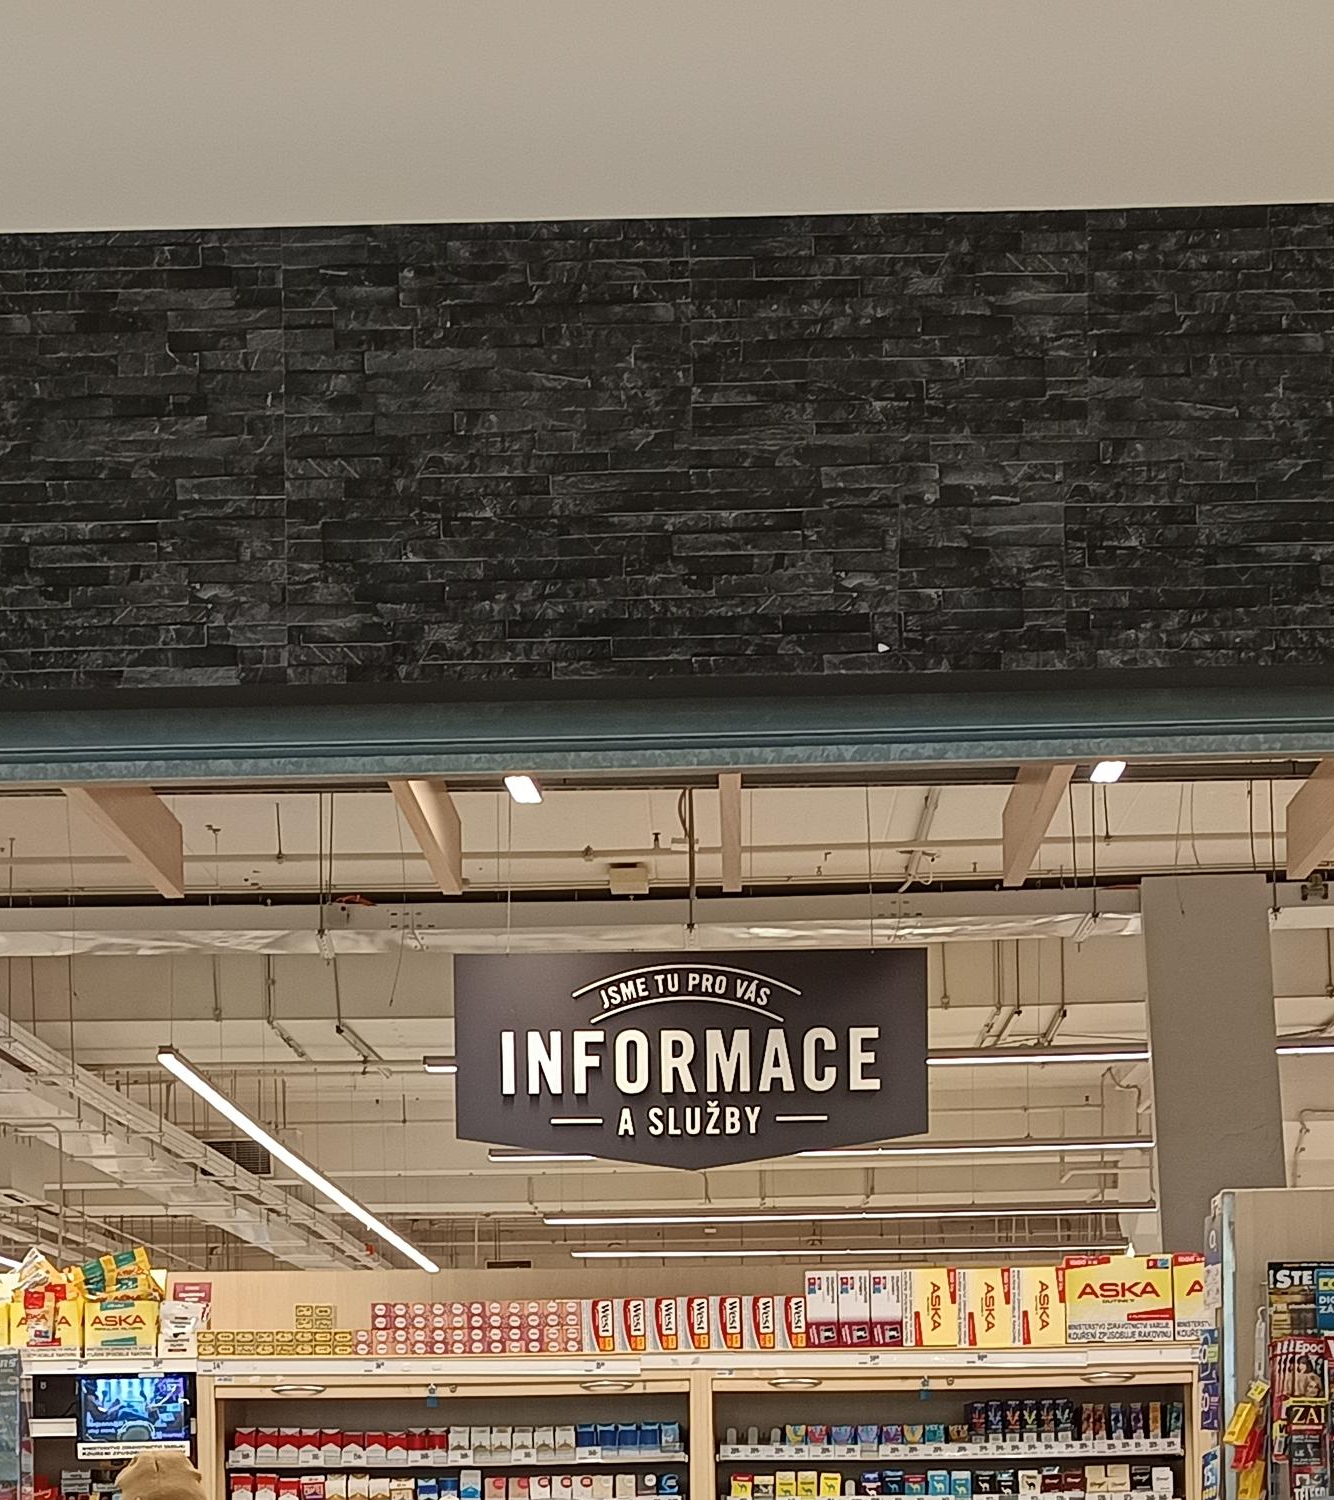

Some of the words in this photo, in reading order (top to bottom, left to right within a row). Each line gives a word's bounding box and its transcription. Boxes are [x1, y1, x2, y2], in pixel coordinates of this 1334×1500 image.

[601, 977, 649, 1010] JSME
[654, 973, 679, 993] TU
[687, 972, 727, 994] PRO
[735, 977, 771, 1006] VÁS
[500, 1026, 882, 1096] INFORMACE
[617, 1107, 635, 1136] A
[649, 1100, 761, 1135] SLUŽBY
[1038, 1280, 1050, 1331] ASKA
[1077, 1281, 1161, 1299] ASKA
[91, 1314, 146, 1327] ASKA
[600, 1303, 610, 1333] West
[631, 1303, 642, 1333] West
[664, 1302, 673, 1332] West
[695, 1300, 705, 1332] West
[728, 1300, 738, 1331] West
[761, 1300, 771, 1331] West
[793, 1300, 803, 1330] West
[930, 1281, 942, 1331] ASKA
[985, 1281, 996, 1332] ASKA
